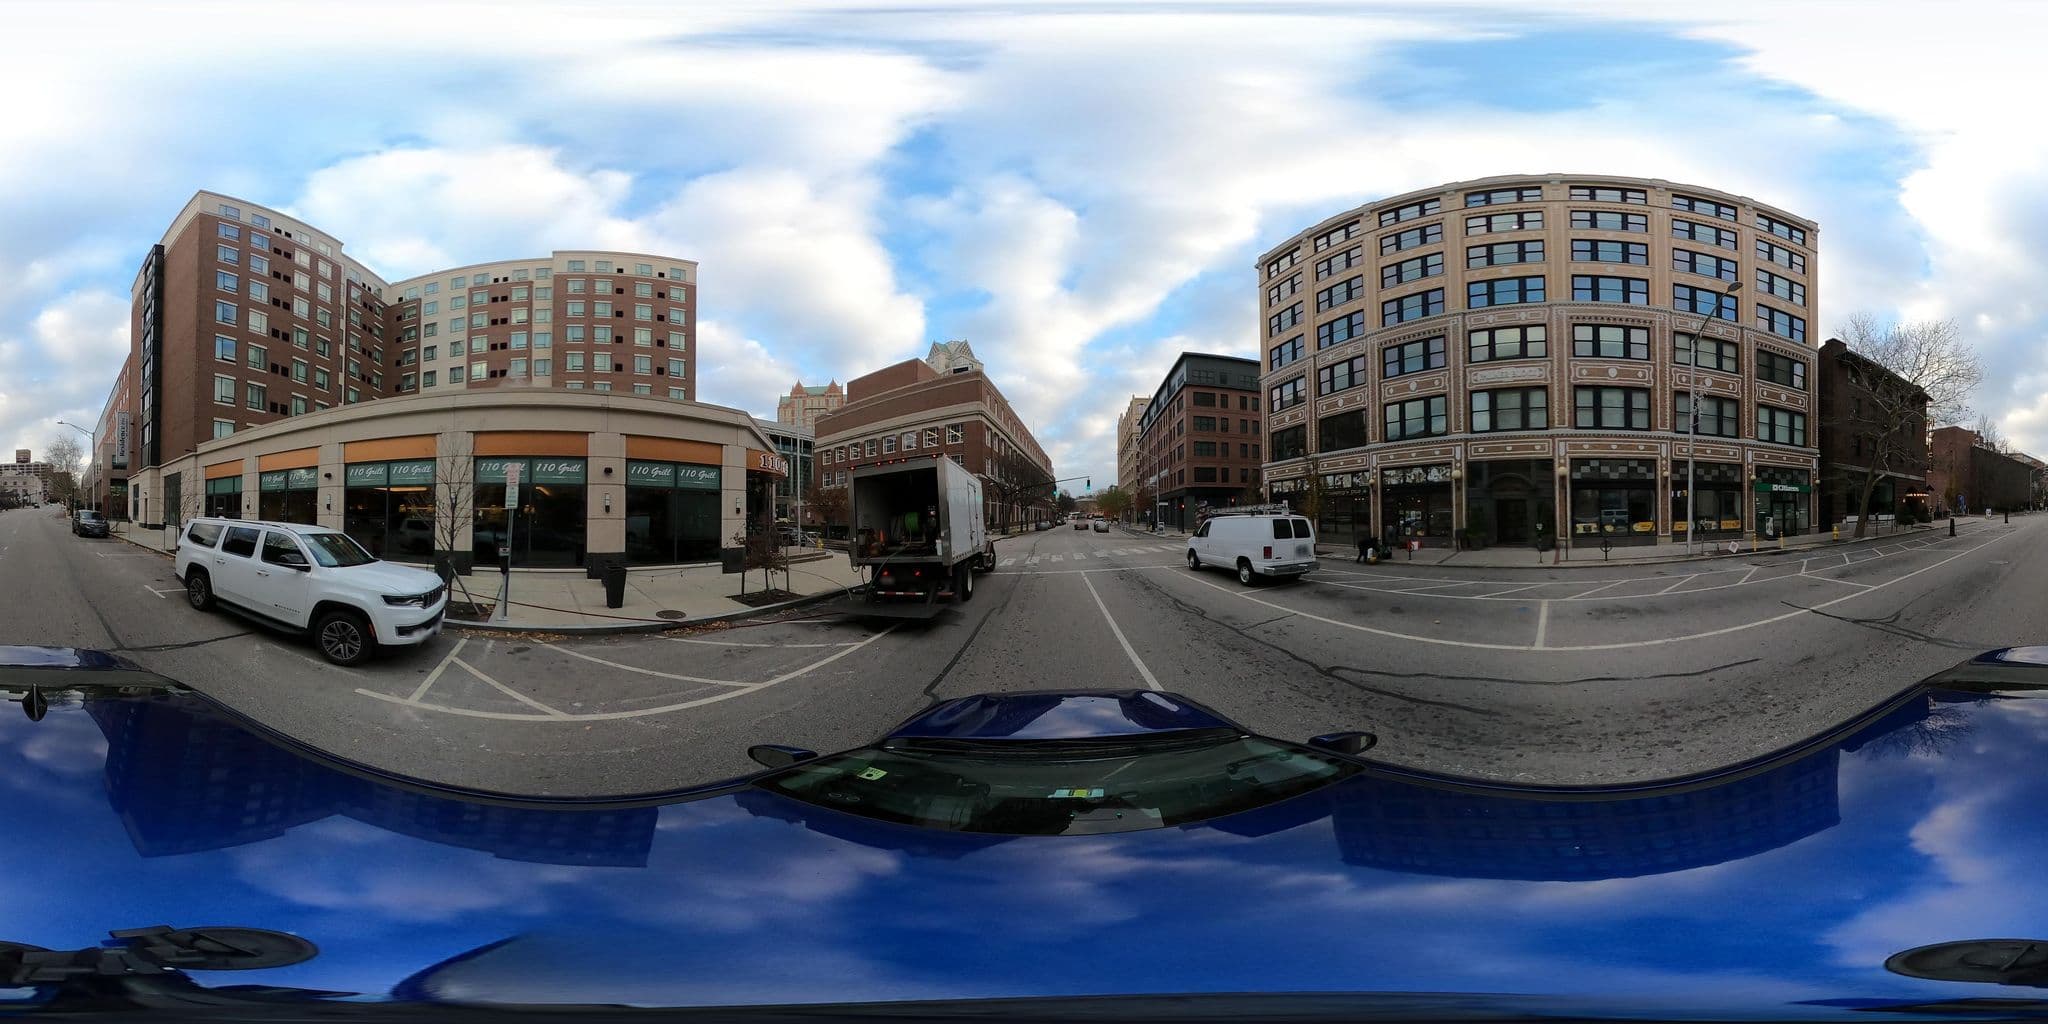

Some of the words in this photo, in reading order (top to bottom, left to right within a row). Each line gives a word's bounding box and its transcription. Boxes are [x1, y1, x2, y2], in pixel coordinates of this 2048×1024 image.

[349, 468, 364, 477] 110
[365, 466, 385, 478] Grill
[392, 464, 410, 475] 110
[411, 464, 433, 476] Grill
[480, 462, 500, 472] 110
[536, 462, 556, 472] 110
[557, 462, 583, 475] Grill
[630, 466, 650, 475] 110
[651, 466, 673, 478] Grill
[290, 472, 301, 481] 110
[680, 469, 697, 478] 110
[697, 470, 718, 481] Grill
